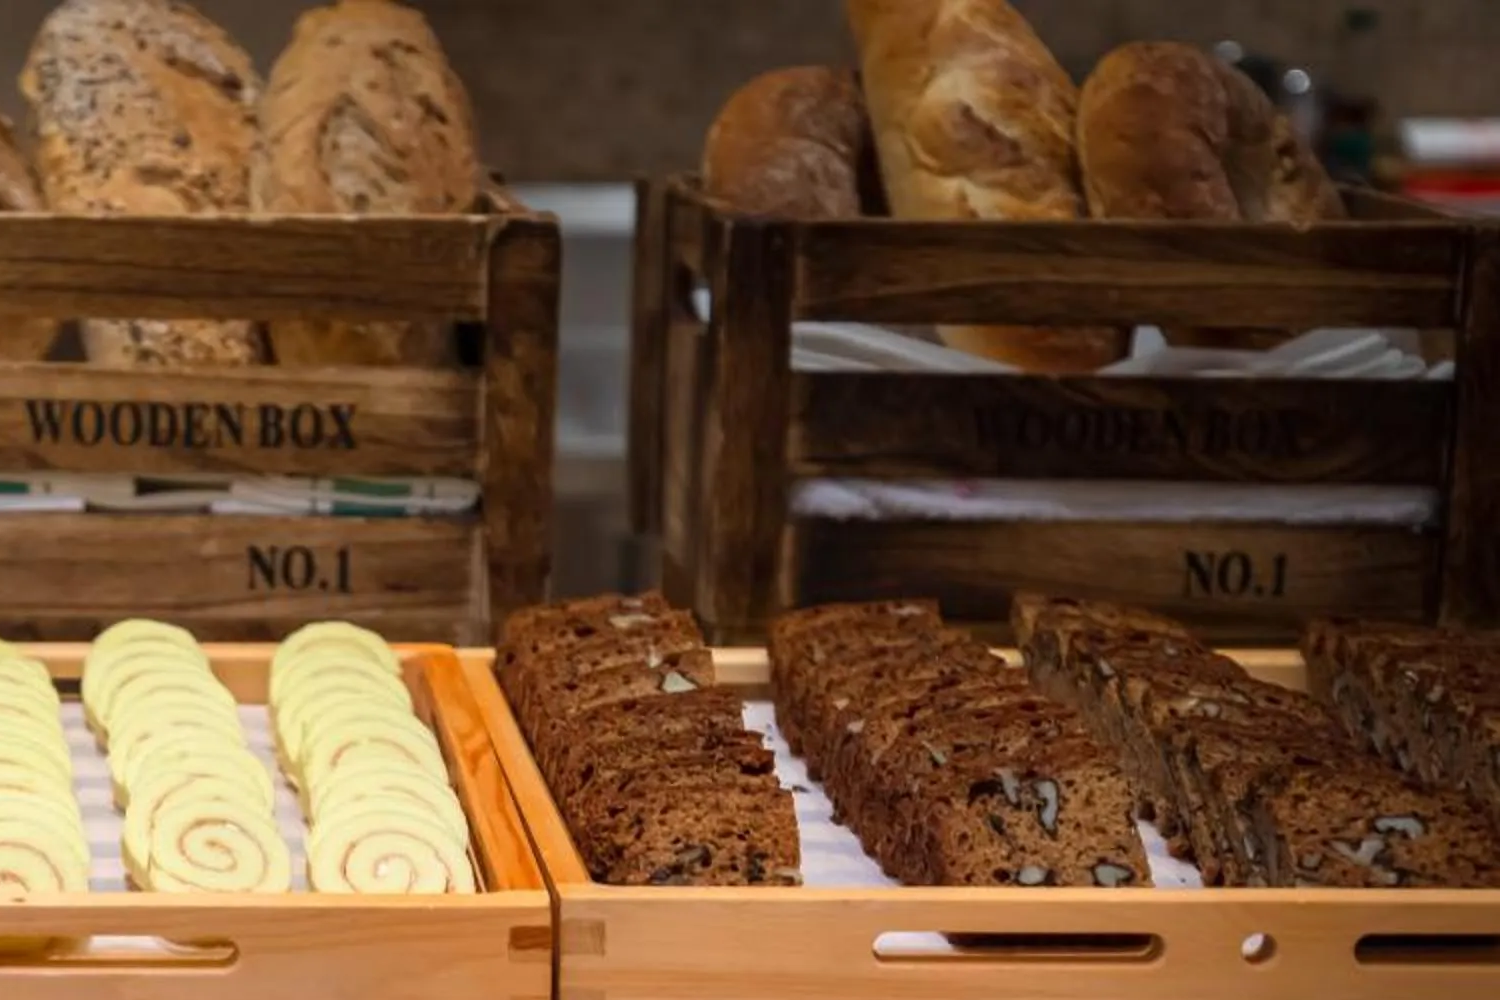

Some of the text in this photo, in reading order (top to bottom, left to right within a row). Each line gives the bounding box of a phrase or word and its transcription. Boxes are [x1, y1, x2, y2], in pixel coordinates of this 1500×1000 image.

[26, 400, 357, 449] WOODEN BOX
[974, 406, 1302, 457] WOODEN BOX
[247, 545, 352, 593] NO.1
[1184, 550, 1288, 598] NO.1
